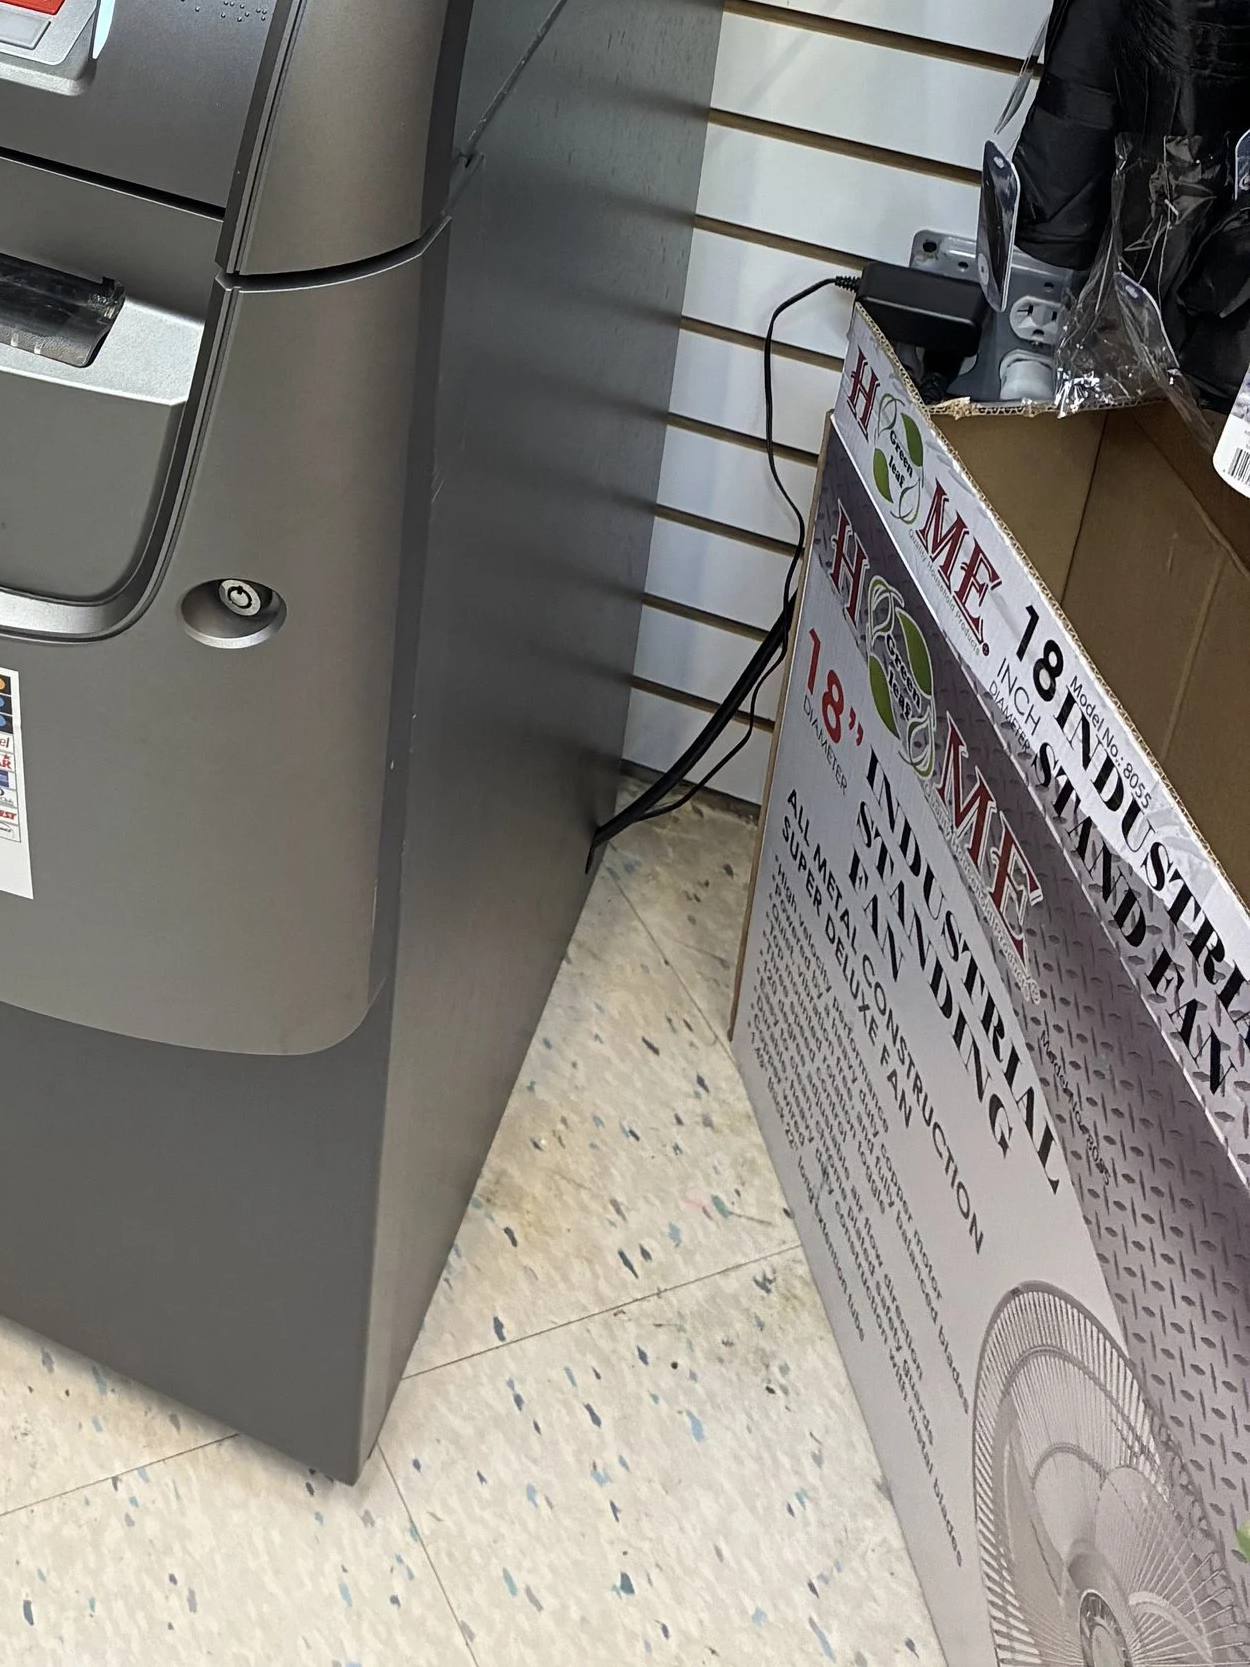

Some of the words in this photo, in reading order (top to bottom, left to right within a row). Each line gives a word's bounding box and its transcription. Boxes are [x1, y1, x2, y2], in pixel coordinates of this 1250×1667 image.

[888, 454, 906, 489] leaf
[889, 430, 913, 479] Green
[908, 528, 928, 563] Quality
[927, 559, 955, 613] Household
[953, 609, 981, 657] Products
[1016, 605, 1064, 702] 18
[885, 633, 921, 711] Green
[887, 665, 913, 721] leaf
[989, 680, 1031, 755] DIAMETER
[997, 657, 1041, 736] INCH
[803, 694, 848, 796] DIAMETER
[1070, 675, 1104, 732] Model
[1123, 762, 1152, 809] 8055
[782, 815, 822, 917] SUPER
[825, 913, 879, 1046] DELUXE
[880, 1043, 912, 1129] FAN
[849, 844, 905, 983] FAN
[857, 801, 1014, 1159] STANDING
[867, 744, 1060, 1195] INDUSTRIAL
[1031, 742, 1147, 948] STAND
[1145, 942, 1238, 1096] FAN
[787, 789, 810, 846] ALL
[814, 843, 857, 955] METAL
[862, 953, 983, 1255] CONSTRUCTION
[797, 910, 832, 998] velocity
[831, 990, 890, 1136] performance
[796, 960, 835, 1059] vibration
[834, 1053, 856, 1111] free,
[855, 1107, 874, 1156] and
[873, 1152, 896, 1214] fully
[894, 1208, 939, 1326] balanced
[936, 1322, 971, 1416] blades
[830, 1016, 858, 1088] heavy
[857, 1083, 880, 1143] duty
[879, 1139, 913, 1228] copper
[912, 1224, 943, 1306] motor
